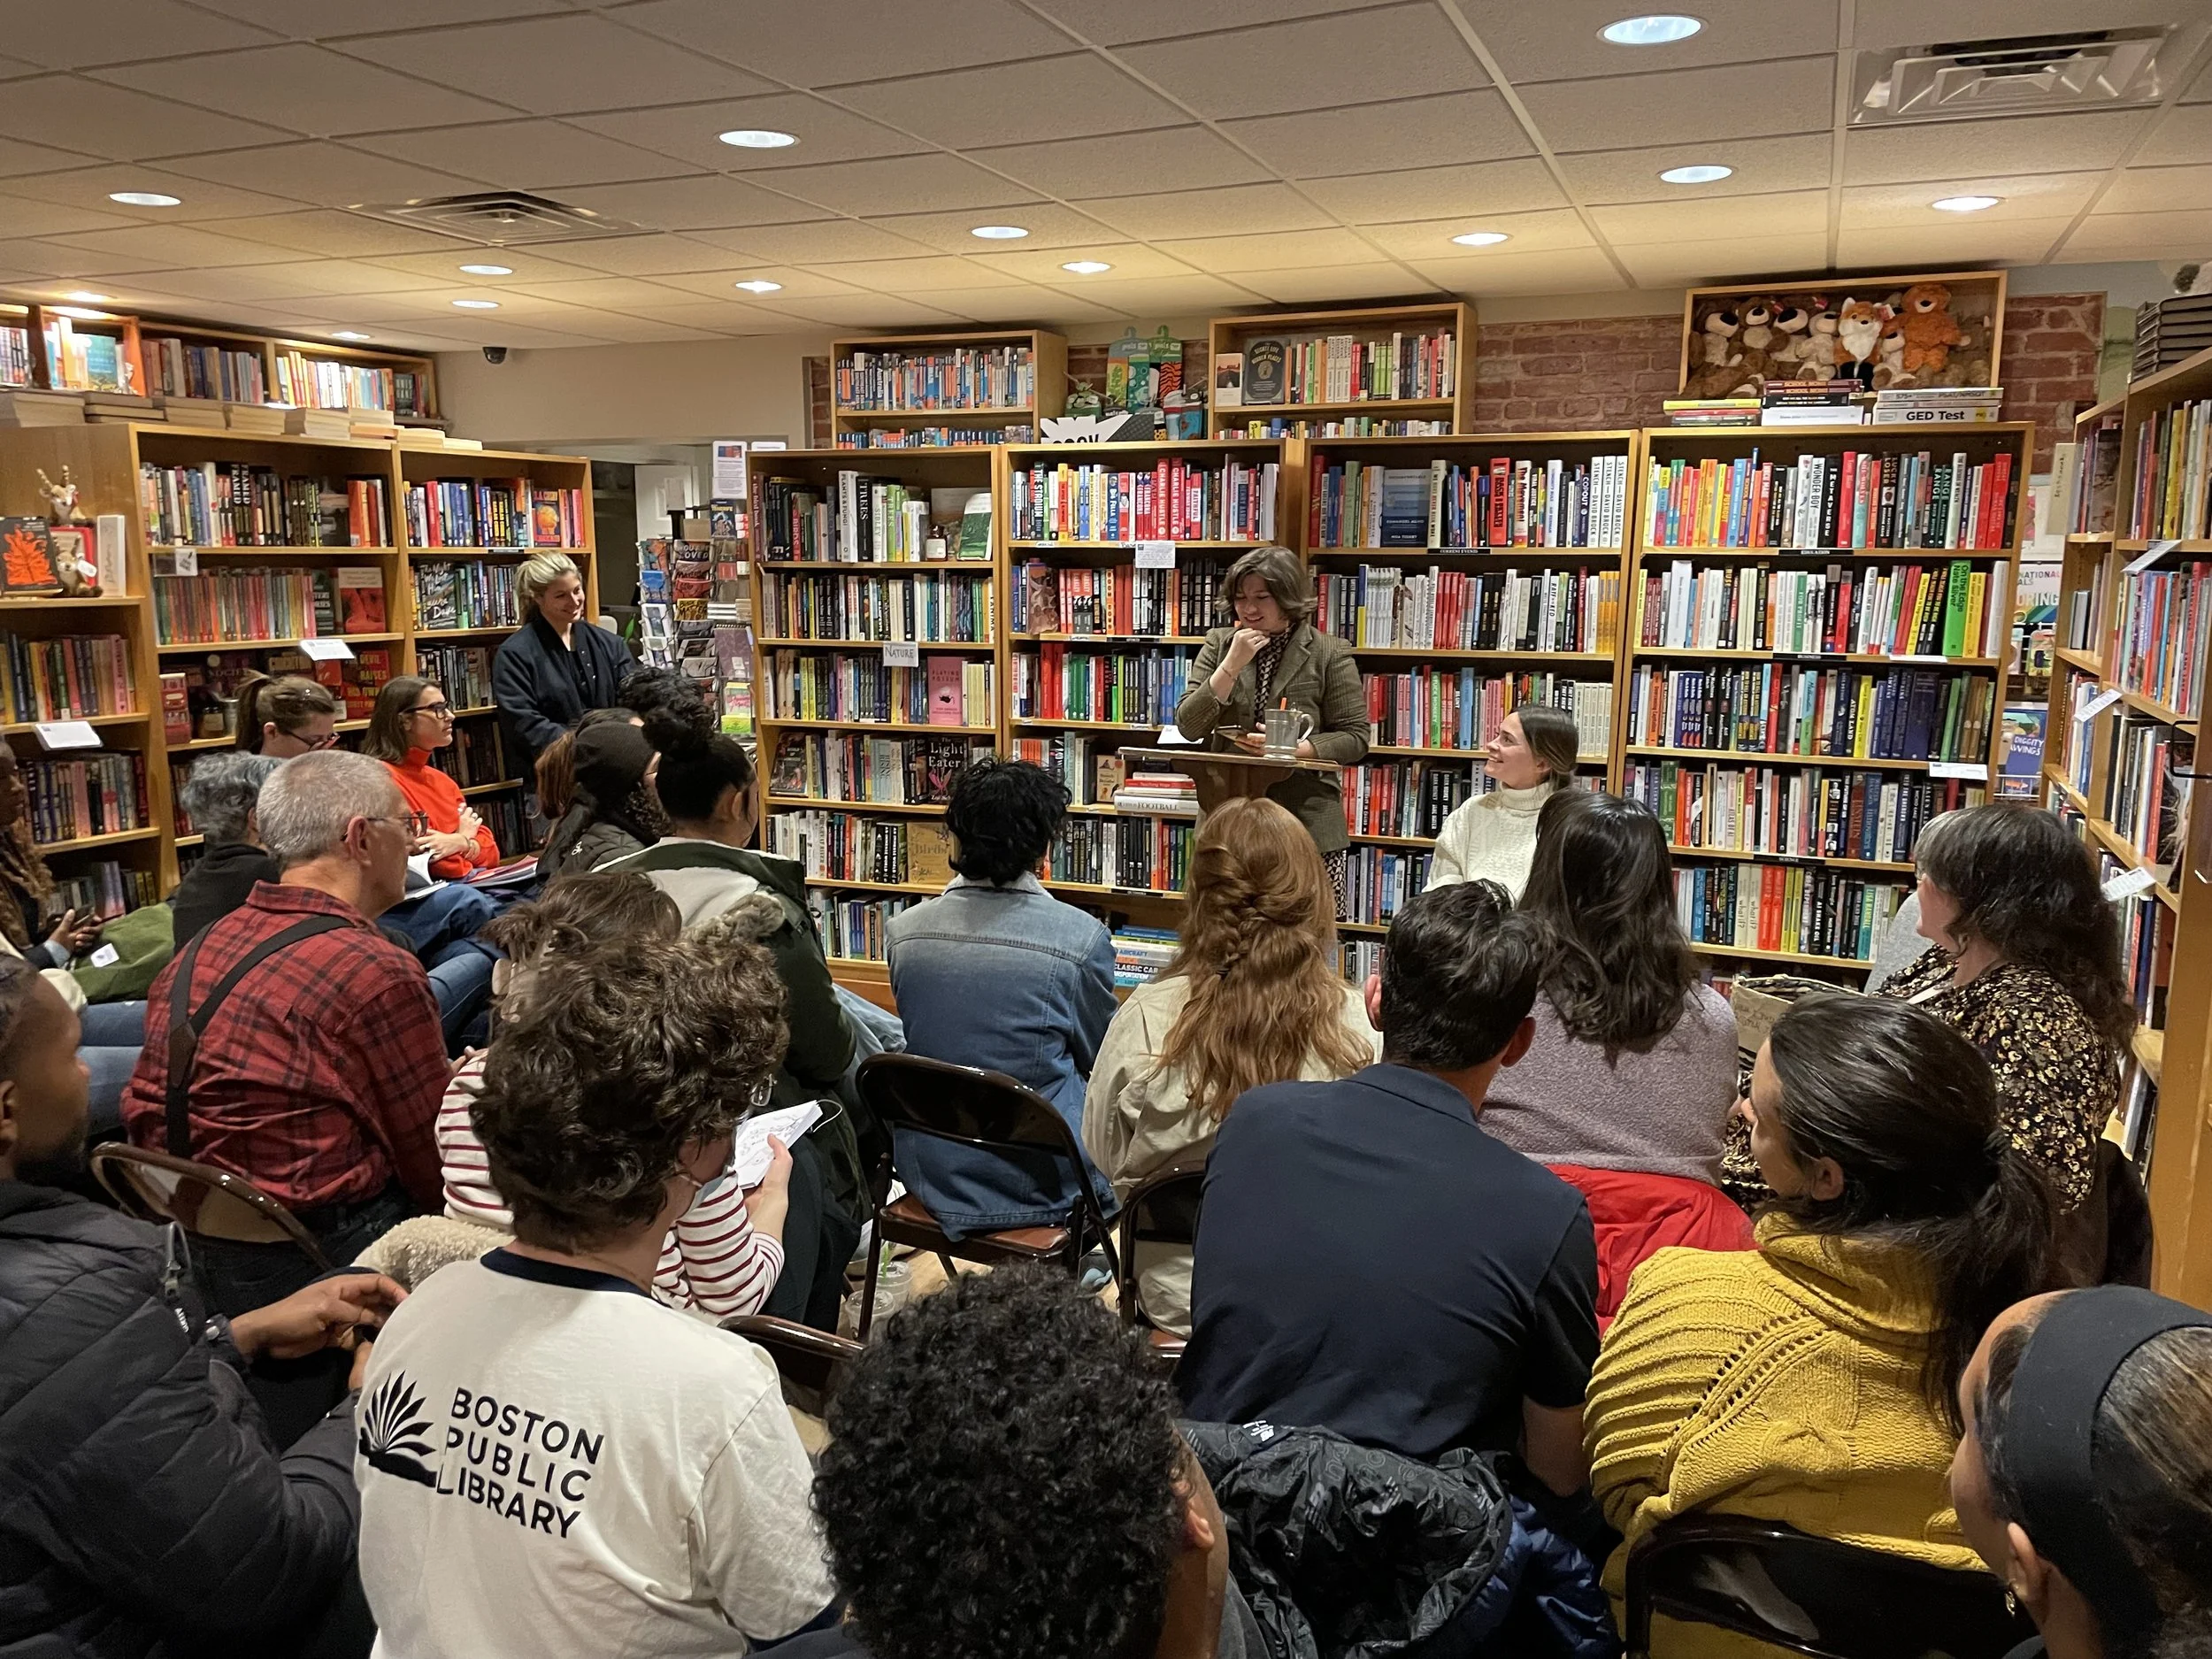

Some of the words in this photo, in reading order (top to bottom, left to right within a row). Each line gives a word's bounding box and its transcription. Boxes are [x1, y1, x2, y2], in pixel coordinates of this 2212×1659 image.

[1906, 411, 1934, 420] GED
[1939, 411, 1964, 419] Test
[1034, 469, 1043, 486] THE
[1518, 467, 1527, 481] The
[1813, 464, 1823, 493] WONDER
[860, 483, 869, 520] TREES
[1516, 482, 1526, 521] Movement
[1810, 495, 1821, 509] BOY
[1824, 474, 1837, 536] METAVERSE
[1961, 565, 1968, 577] On
[1956, 592, 1965, 612] Edge
[360, 654, 380, 664] DEVIL
[885, 645, 915, 658] NATURE
[931, 742, 963, 757] Light
[2015, 736, 2044, 747] DIGGITY
[1866, 889, 1875, 902] LISA
[1863, 904, 1873, 928] RANDALL
[450, 1386, 604, 1465] BOSTON
[443, 1425, 591, 1502] PUBLIC
[436, 1463, 581, 1539] LIBRARY
